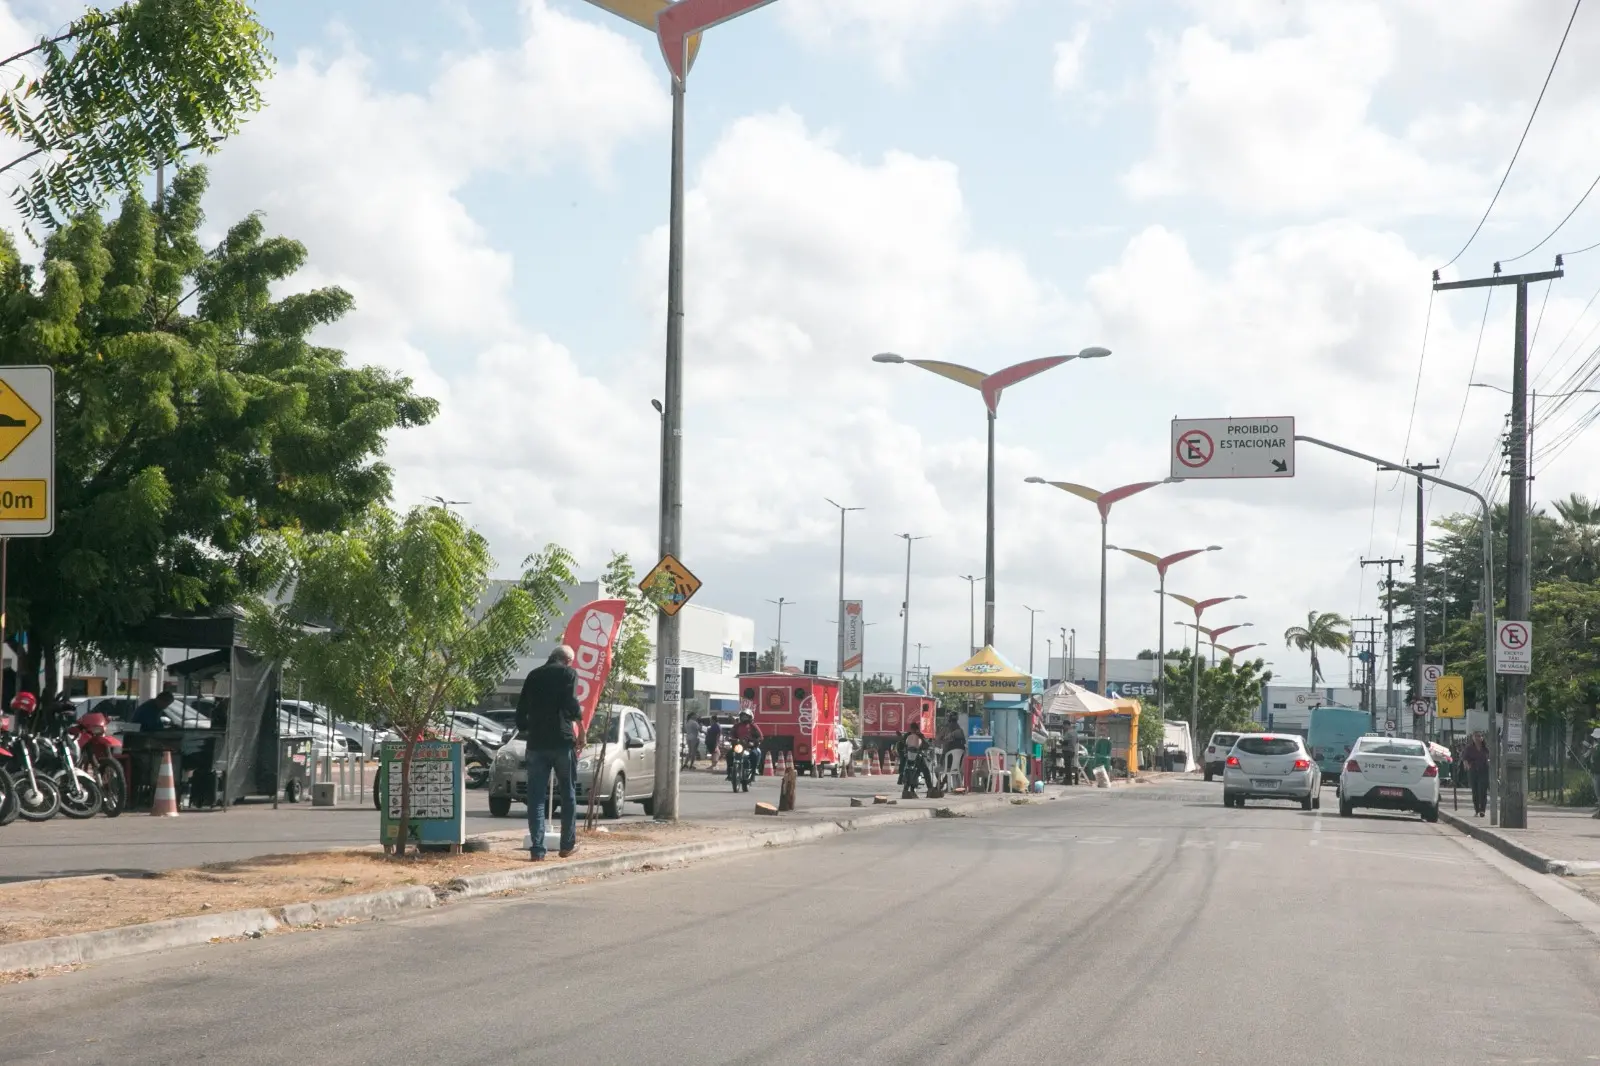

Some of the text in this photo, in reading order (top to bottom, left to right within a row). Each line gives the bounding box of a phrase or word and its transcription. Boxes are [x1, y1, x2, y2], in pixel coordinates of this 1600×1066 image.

[1227, 424, 1279, 435] PROIBIDO
[1220, 438, 1286, 449] ESTACIONAR
[0, 490, 33, 509] 0m
[946, 679, 987, 688] TOTOLEC
[989, 680, 1017, 688] SHOW
[1121, 682, 1158, 696] Está
